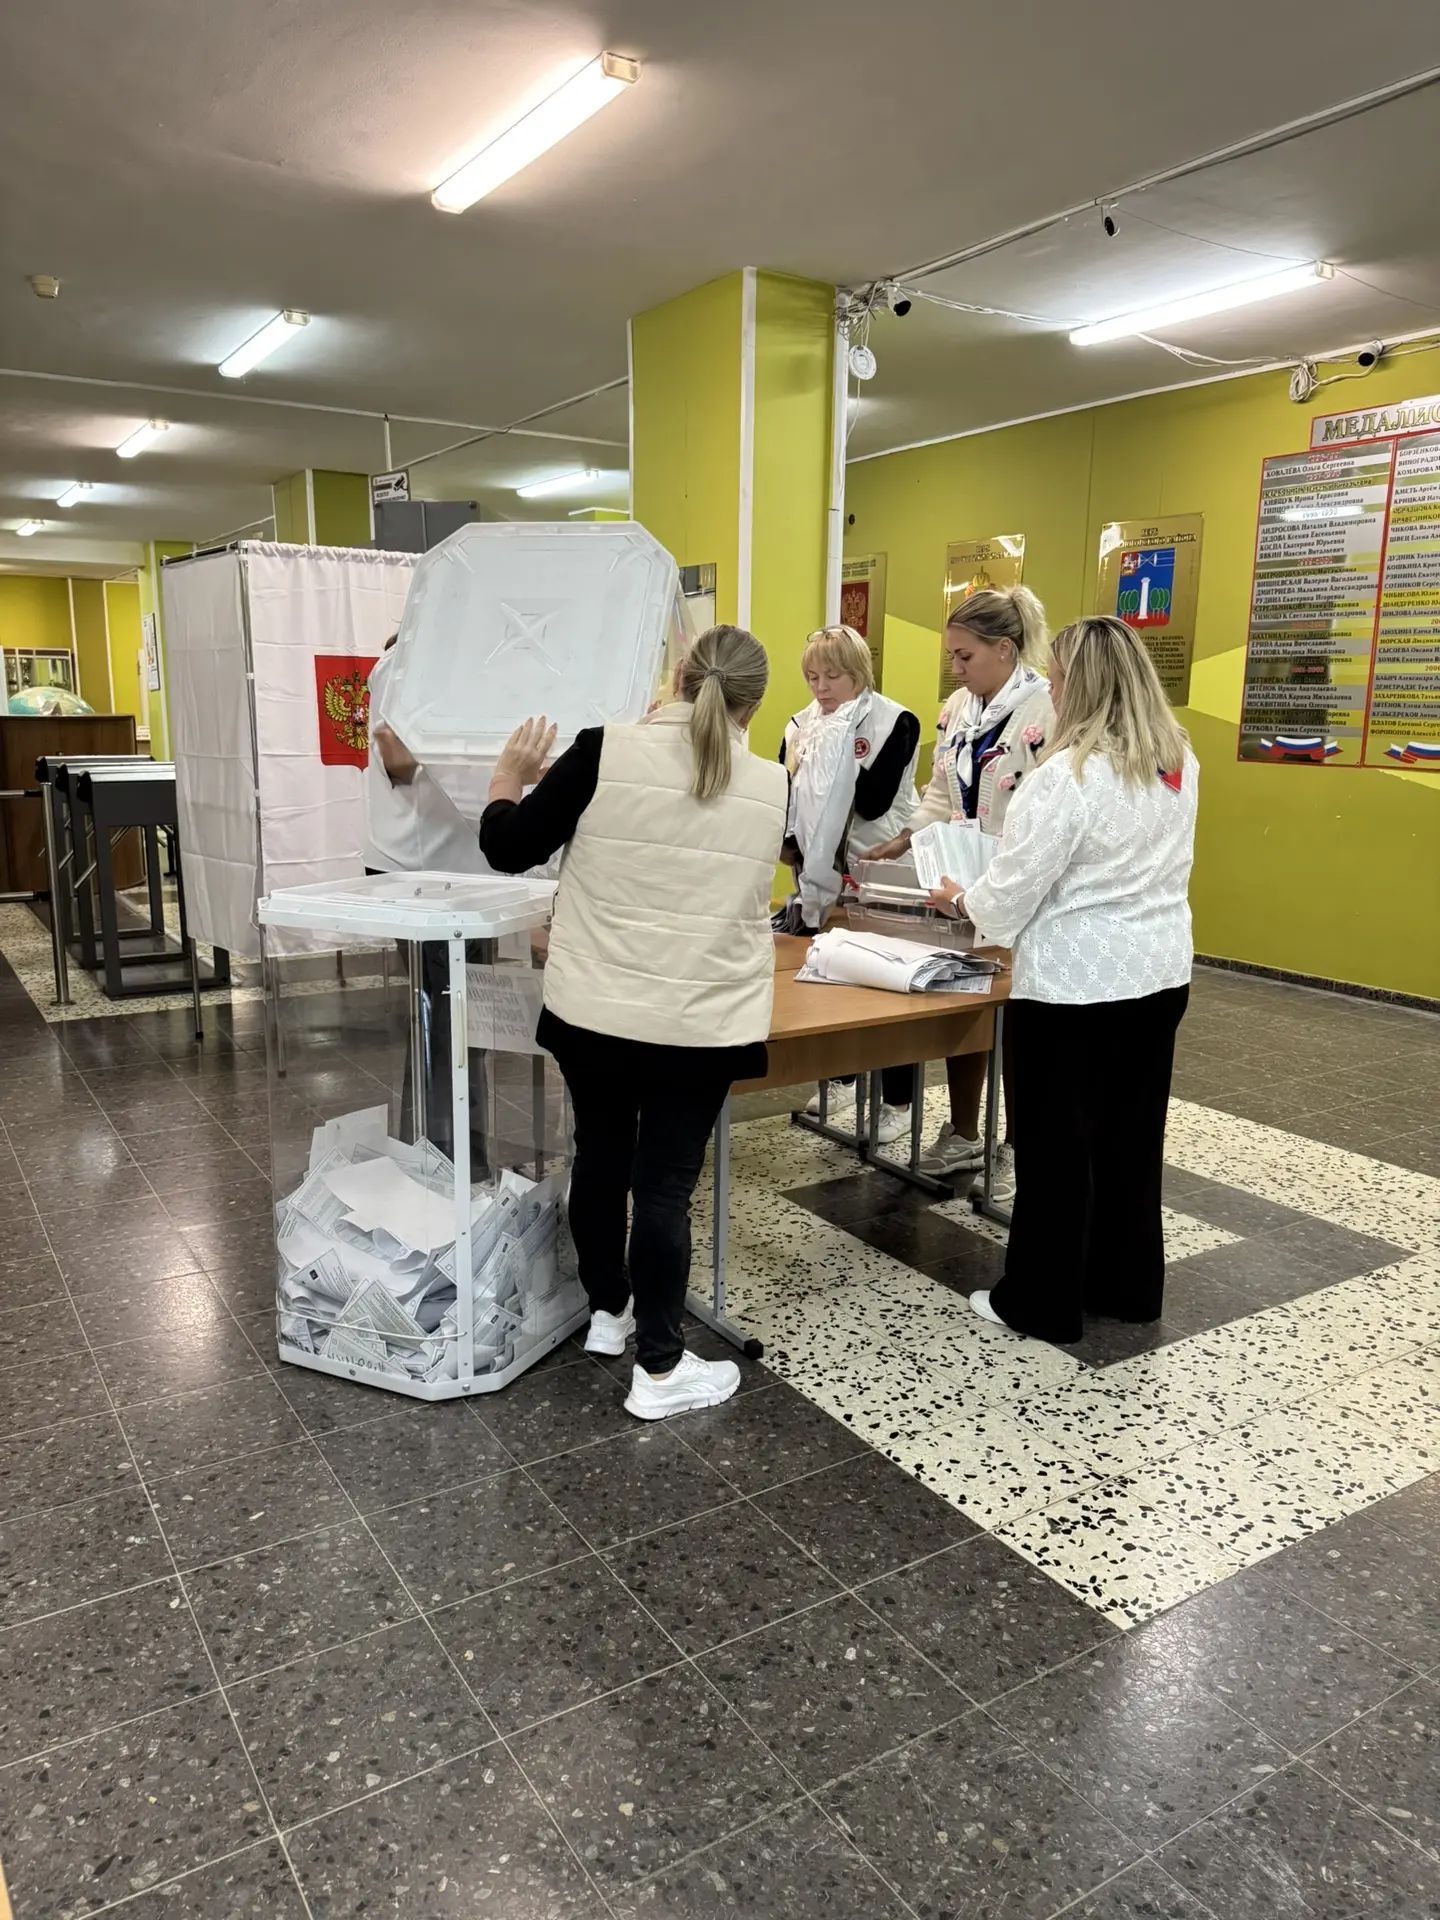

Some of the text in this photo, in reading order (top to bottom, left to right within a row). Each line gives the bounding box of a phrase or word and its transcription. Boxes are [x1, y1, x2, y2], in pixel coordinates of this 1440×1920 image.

[1400, 447, 1440, 457] БОРЗЁНКОВ
[1321, 460, 1355, 471] Сергеевна
[1397, 467, 1433, 476] КОМАРОВА
[1316, 538, 1344, 548] Юрьевна
[1308, 547, 1344, 556] Витальевич
